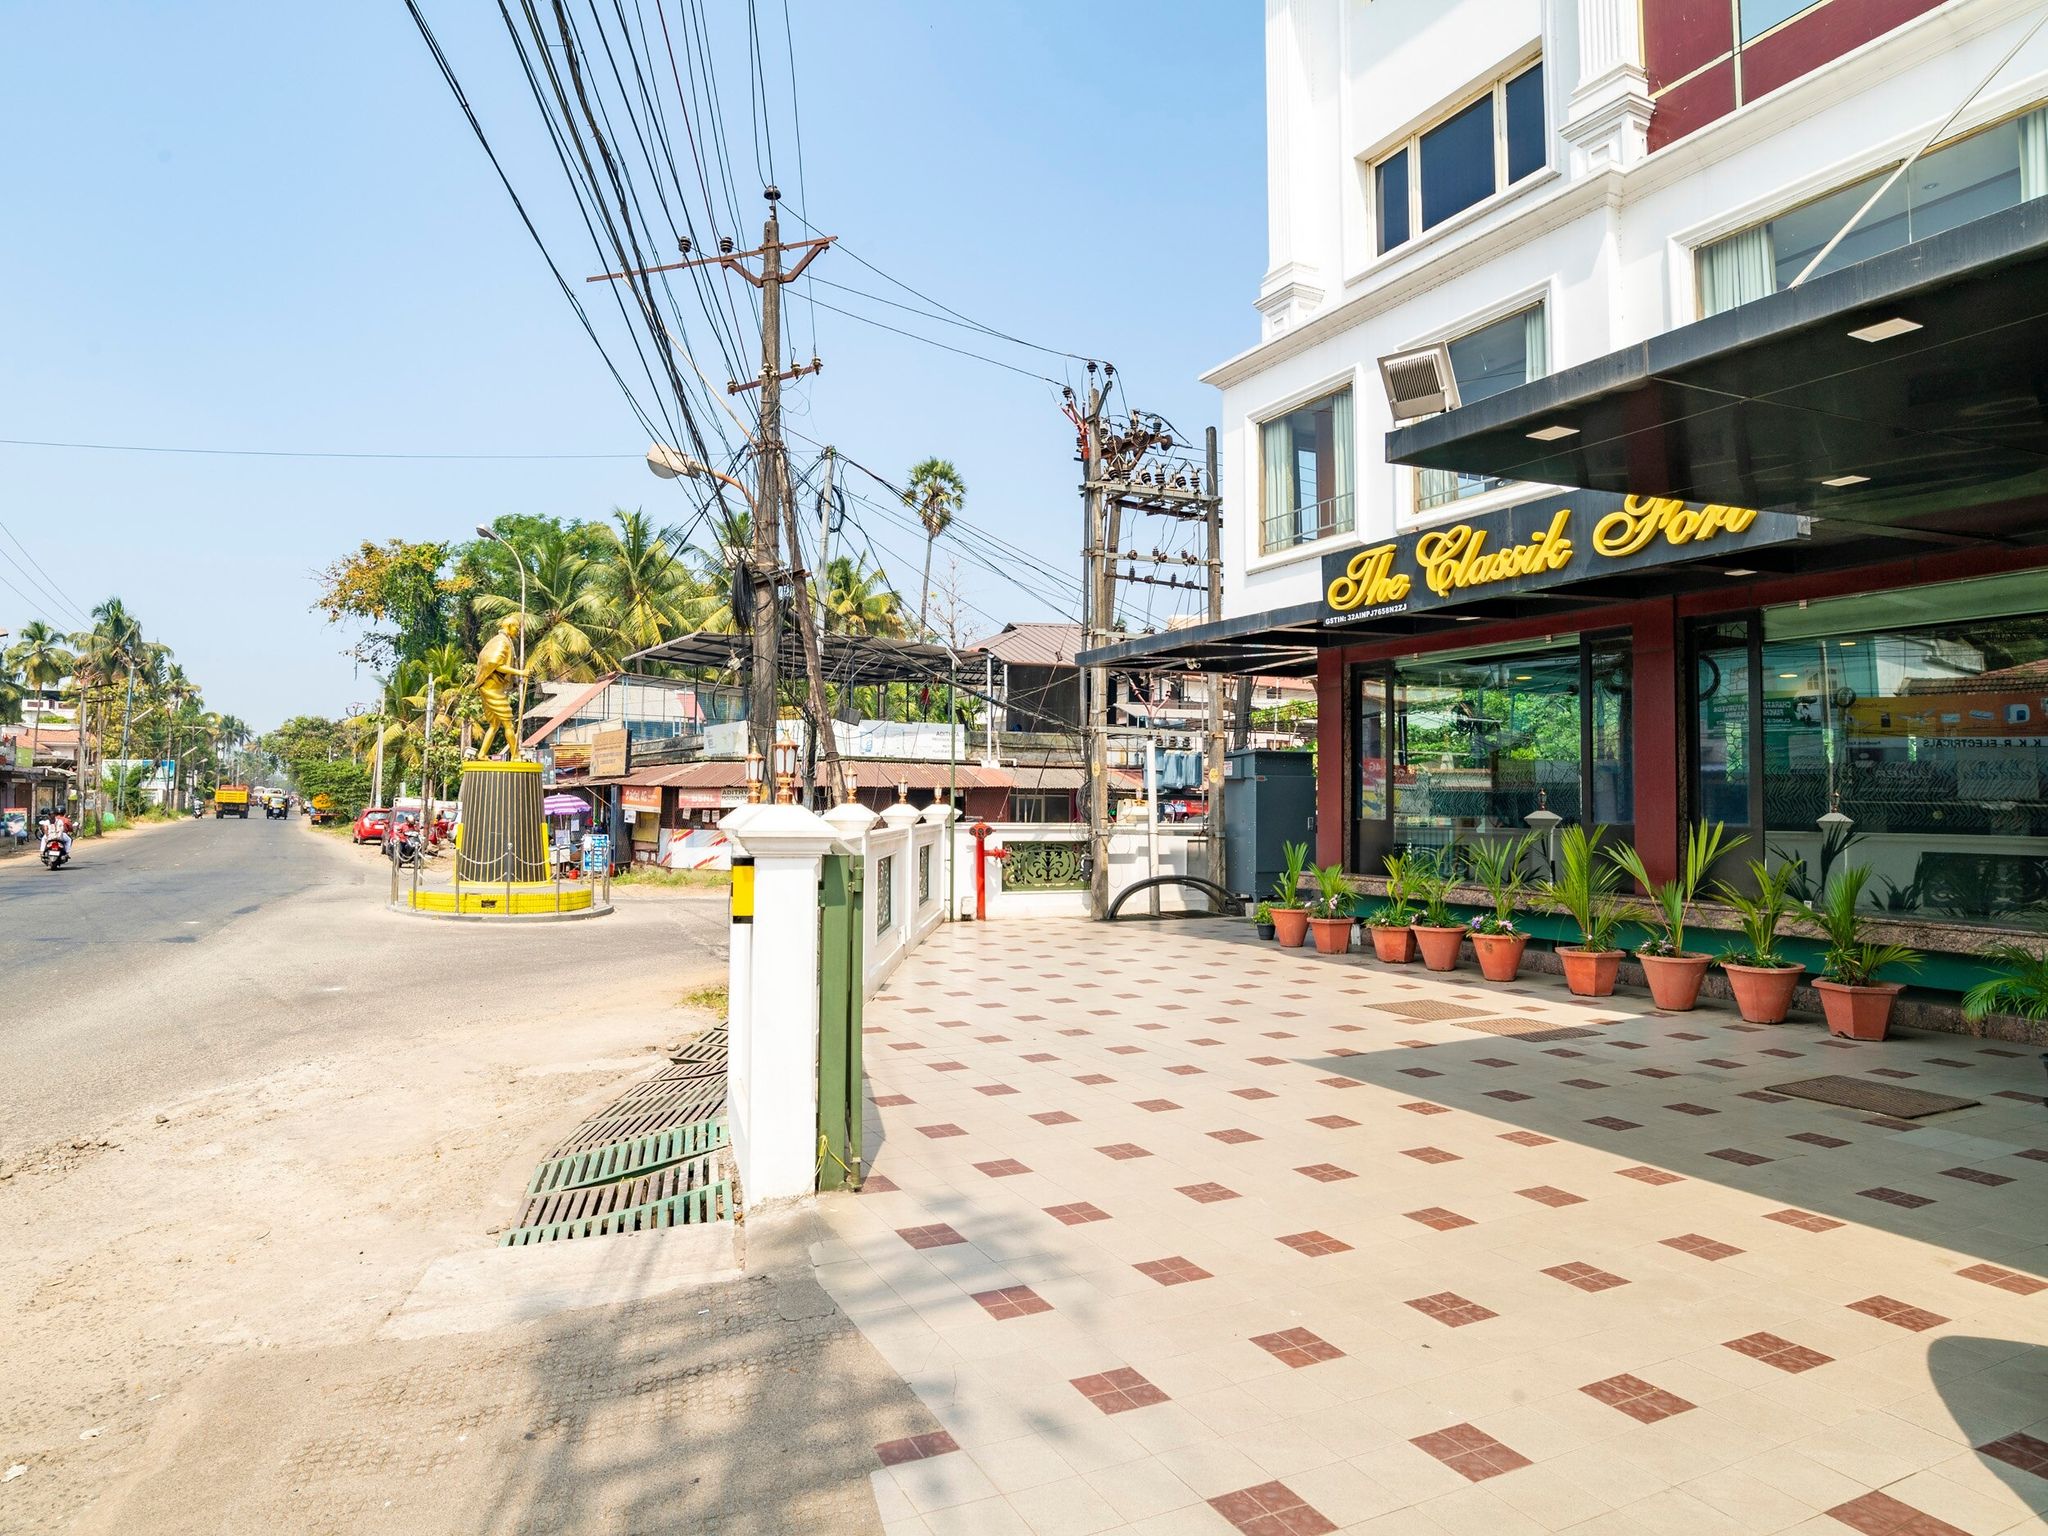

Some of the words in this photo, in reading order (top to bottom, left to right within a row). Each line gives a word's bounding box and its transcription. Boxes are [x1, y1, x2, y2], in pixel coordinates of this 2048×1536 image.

[1327, 544, 1410, 610] The
[1416, 509, 1573, 597] Classik
[1325, 615, 1346, 625] GSTIN:
